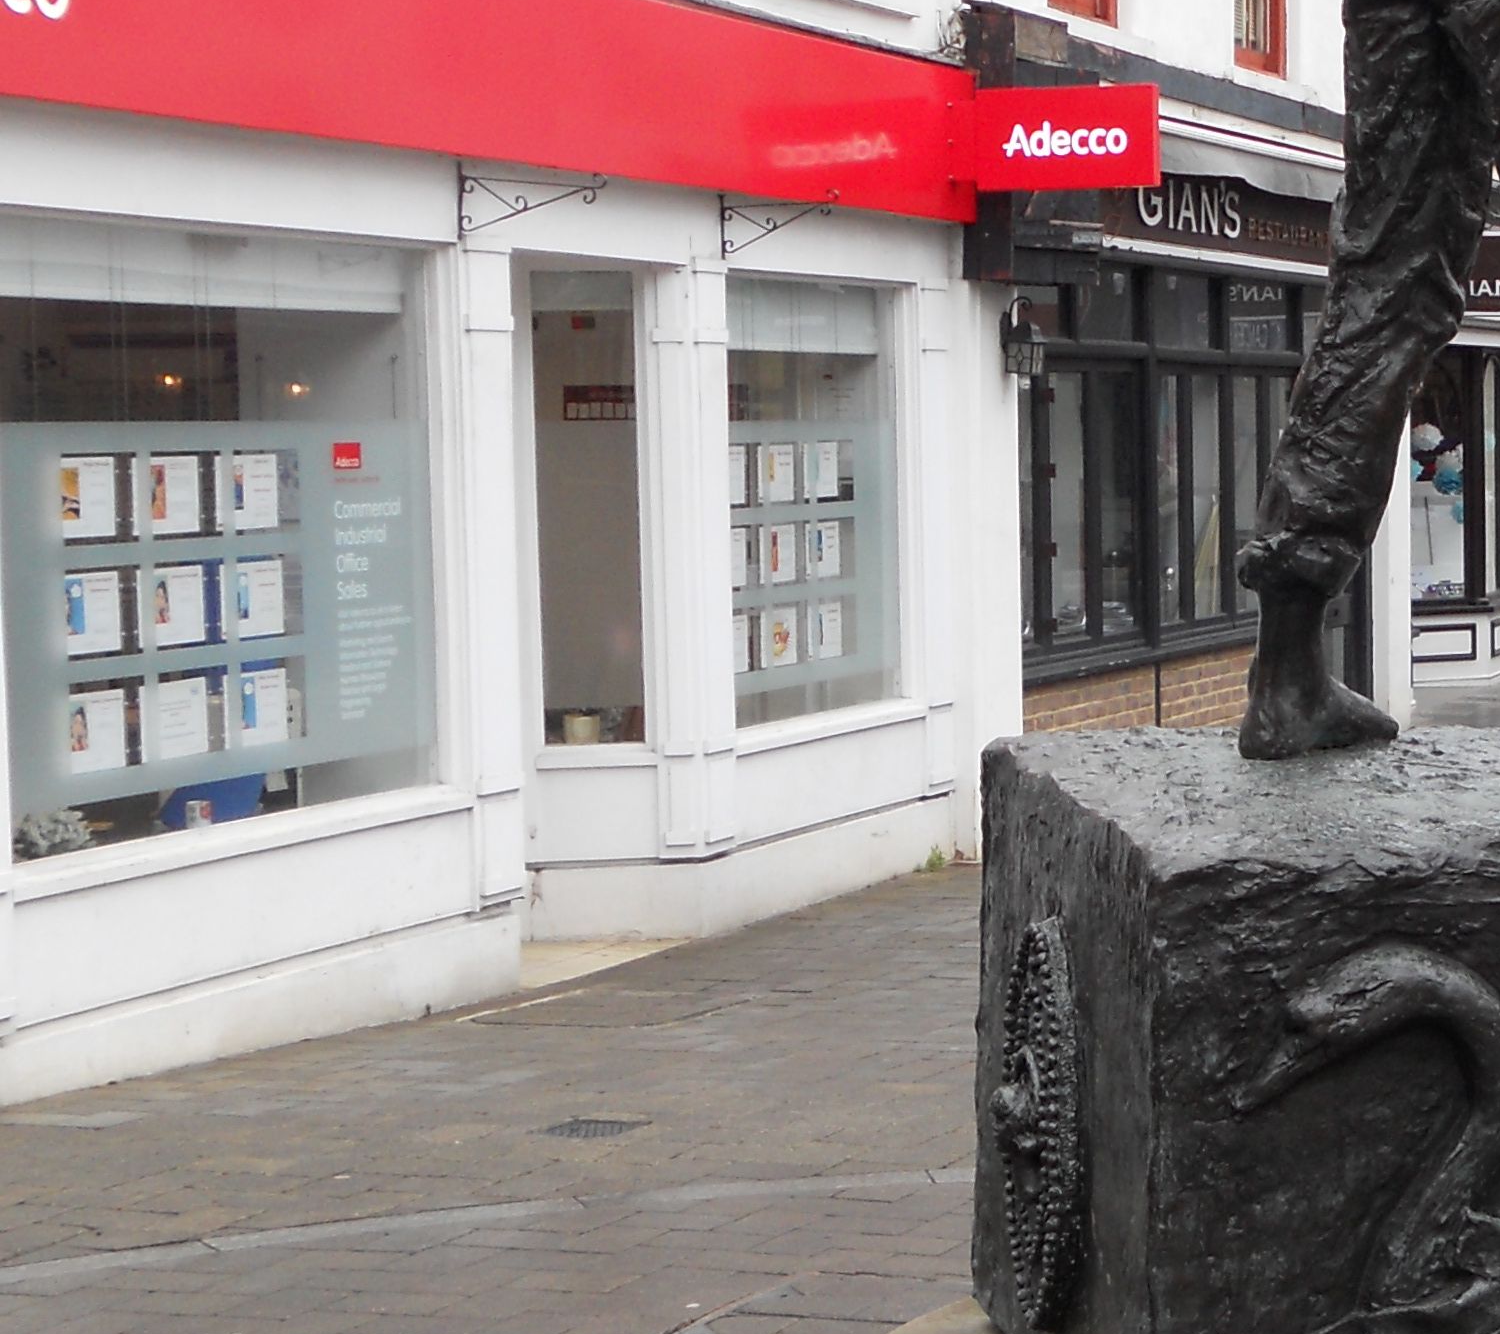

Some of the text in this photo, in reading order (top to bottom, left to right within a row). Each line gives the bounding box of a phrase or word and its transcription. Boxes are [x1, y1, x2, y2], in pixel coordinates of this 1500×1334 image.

[1002, 120, 1128, 158] Adecco
[1138, 179, 1242, 239] GIAN'S
[334, 496, 402, 519] Commercial
[335, 524, 387, 545] Industrial
[336, 553, 369, 573] Office
[337, 580, 368, 600] Sales
